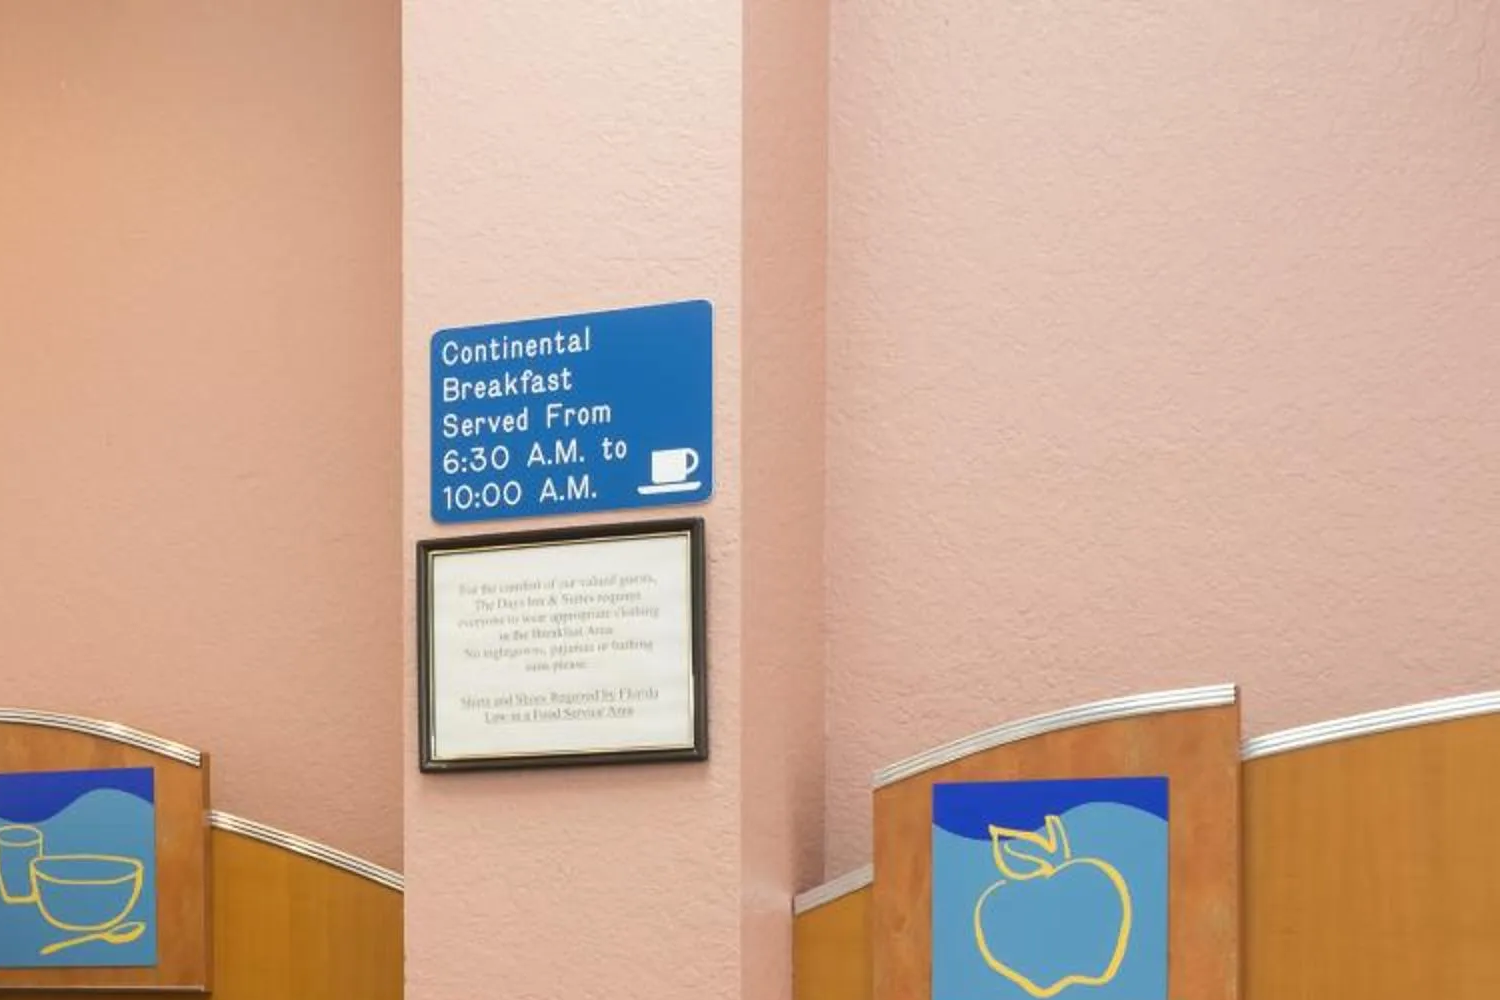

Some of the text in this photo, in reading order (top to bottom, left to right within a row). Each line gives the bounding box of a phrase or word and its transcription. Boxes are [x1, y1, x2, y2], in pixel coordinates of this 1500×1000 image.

[442, 326, 592, 366] Continental
[443, 368, 573, 402] Breakfast
[442, 403, 611, 438] Served From
[442, 437, 627, 474] 6:30 A.M. to
[443, 474, 597, 510] 10:00 A.M.
